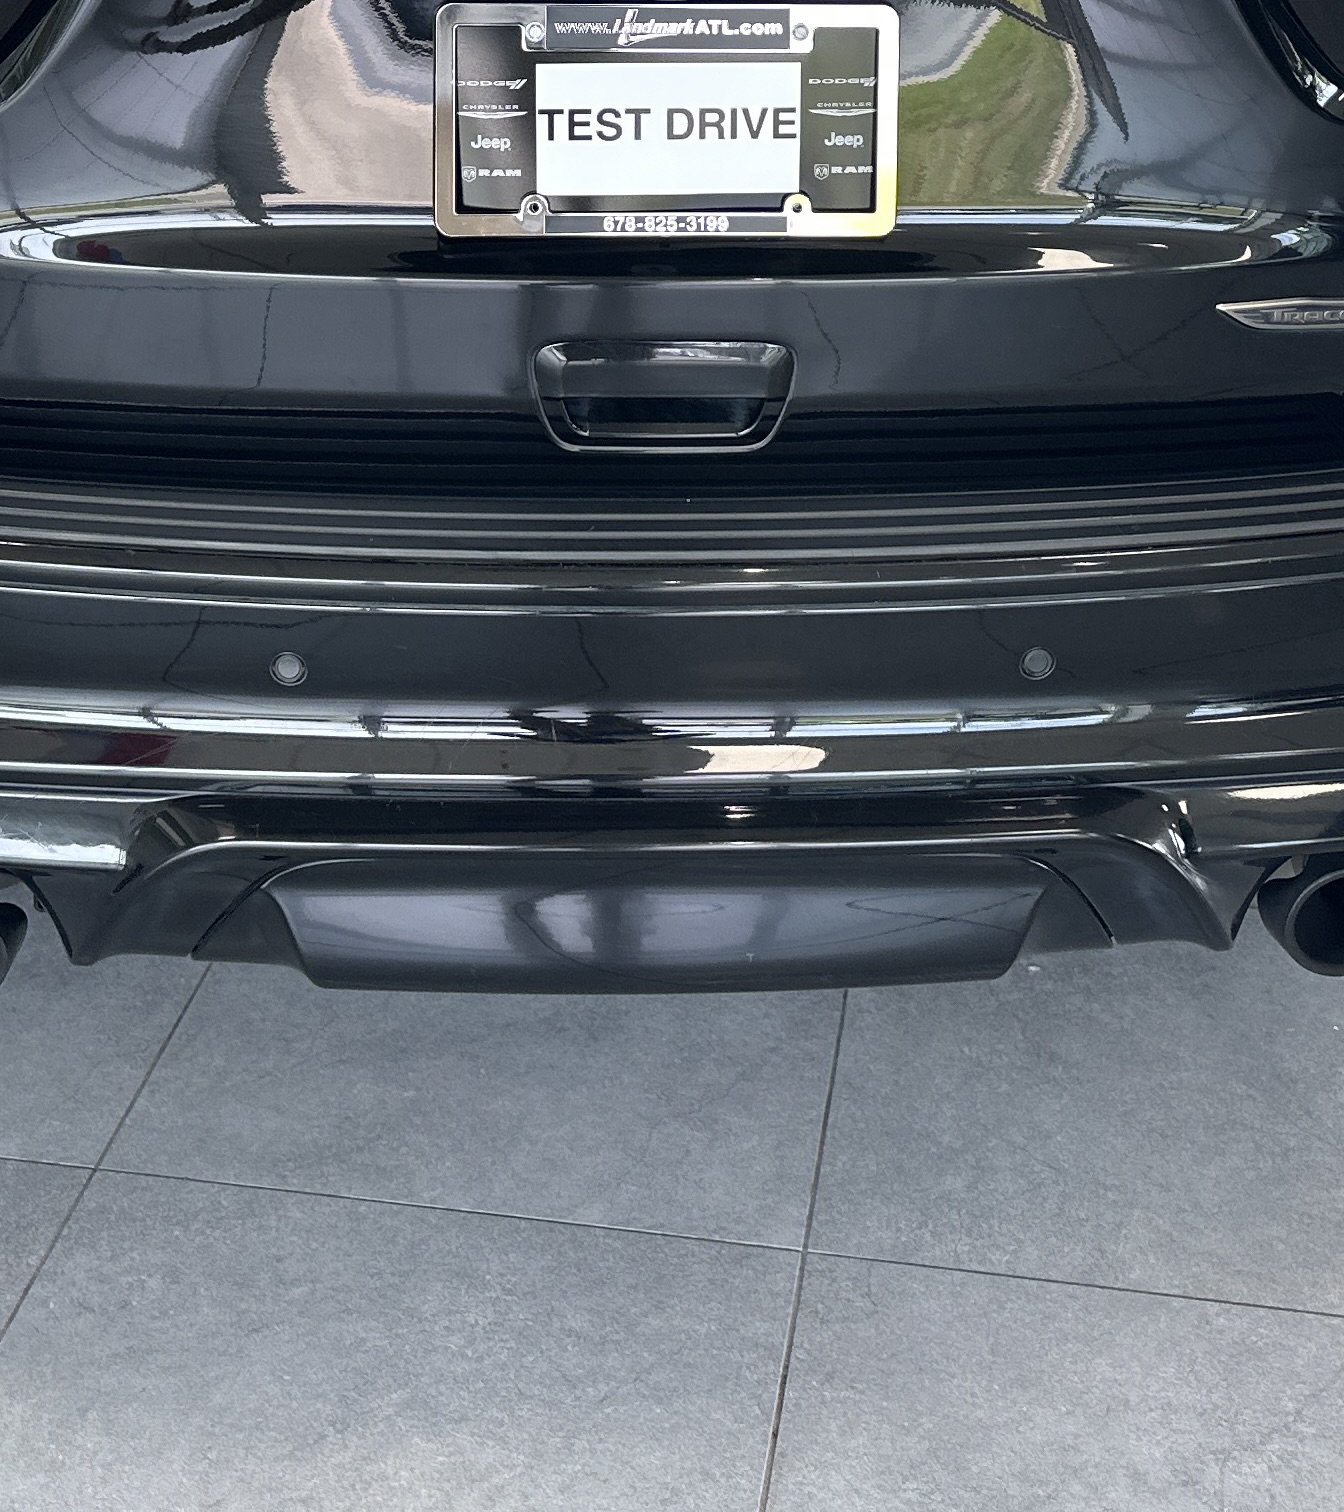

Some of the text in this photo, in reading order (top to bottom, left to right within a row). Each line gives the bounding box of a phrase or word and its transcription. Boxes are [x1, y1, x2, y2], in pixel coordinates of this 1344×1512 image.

[457, 78, 521, 89] DODGE
[808, 77, 872, 87] DODGE
[538, 106, 798, 142] TEST DRIVE
[470, 134, 511, 152] Jeep
[824, 131, 864, 149] Jeep
[478, 169, 522, 177] RAM
[831, 165, 874, 174] RAM
[603, 215, 730, 232] 678-825-3199
